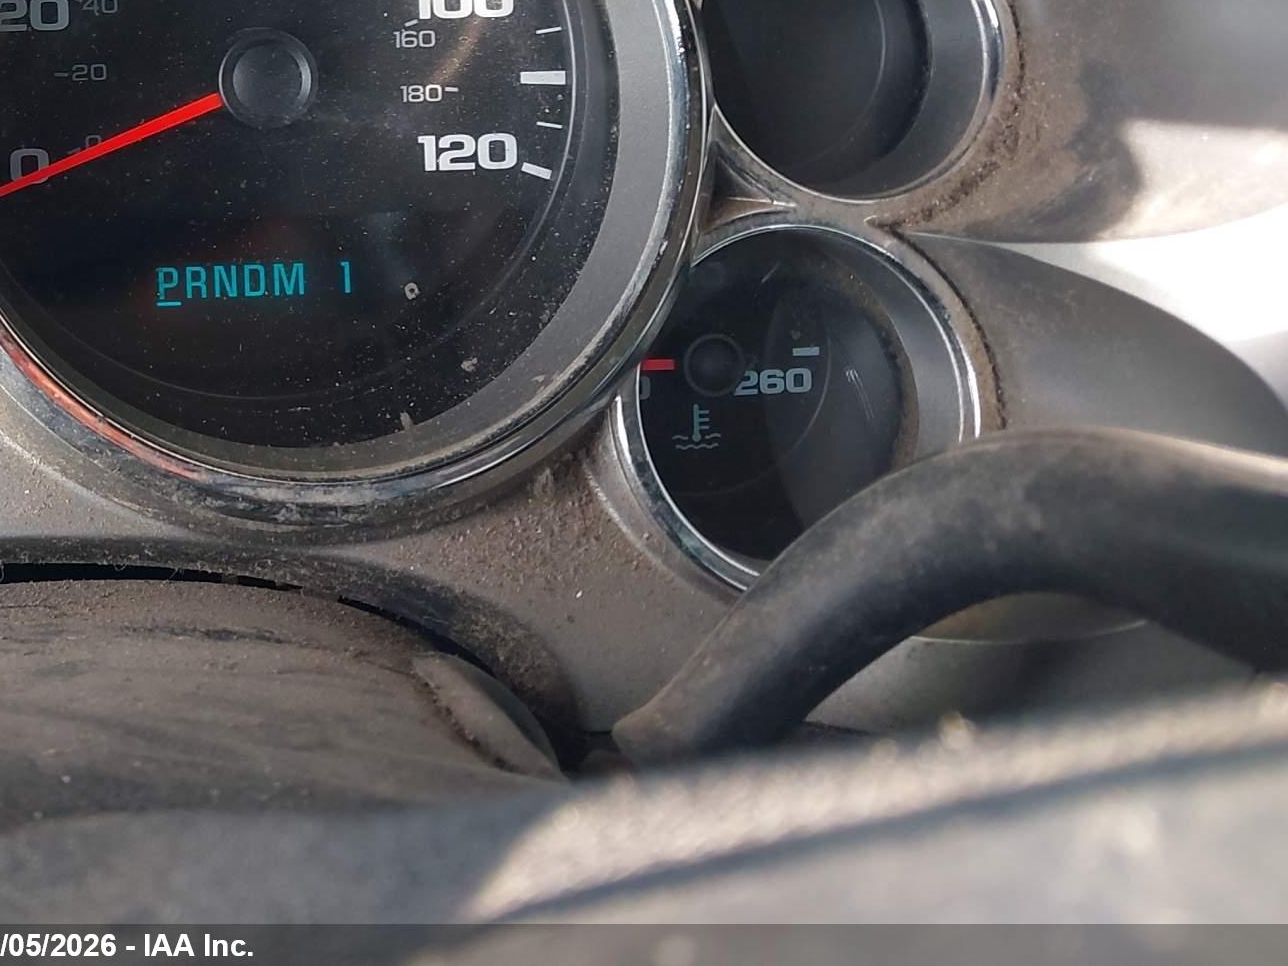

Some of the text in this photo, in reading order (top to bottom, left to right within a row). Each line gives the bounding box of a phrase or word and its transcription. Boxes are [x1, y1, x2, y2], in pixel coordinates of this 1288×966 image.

[393, 30, 435, 49] 160
[71, 63, 107, 82] 20
[400, 84, 442, 103] 180
[10, 148, 50, 185] 0
[417, 134, 519, 172] 120
[156, 262, 352, 302] PRNDM 1
[733, 368, 812, 396] 260
